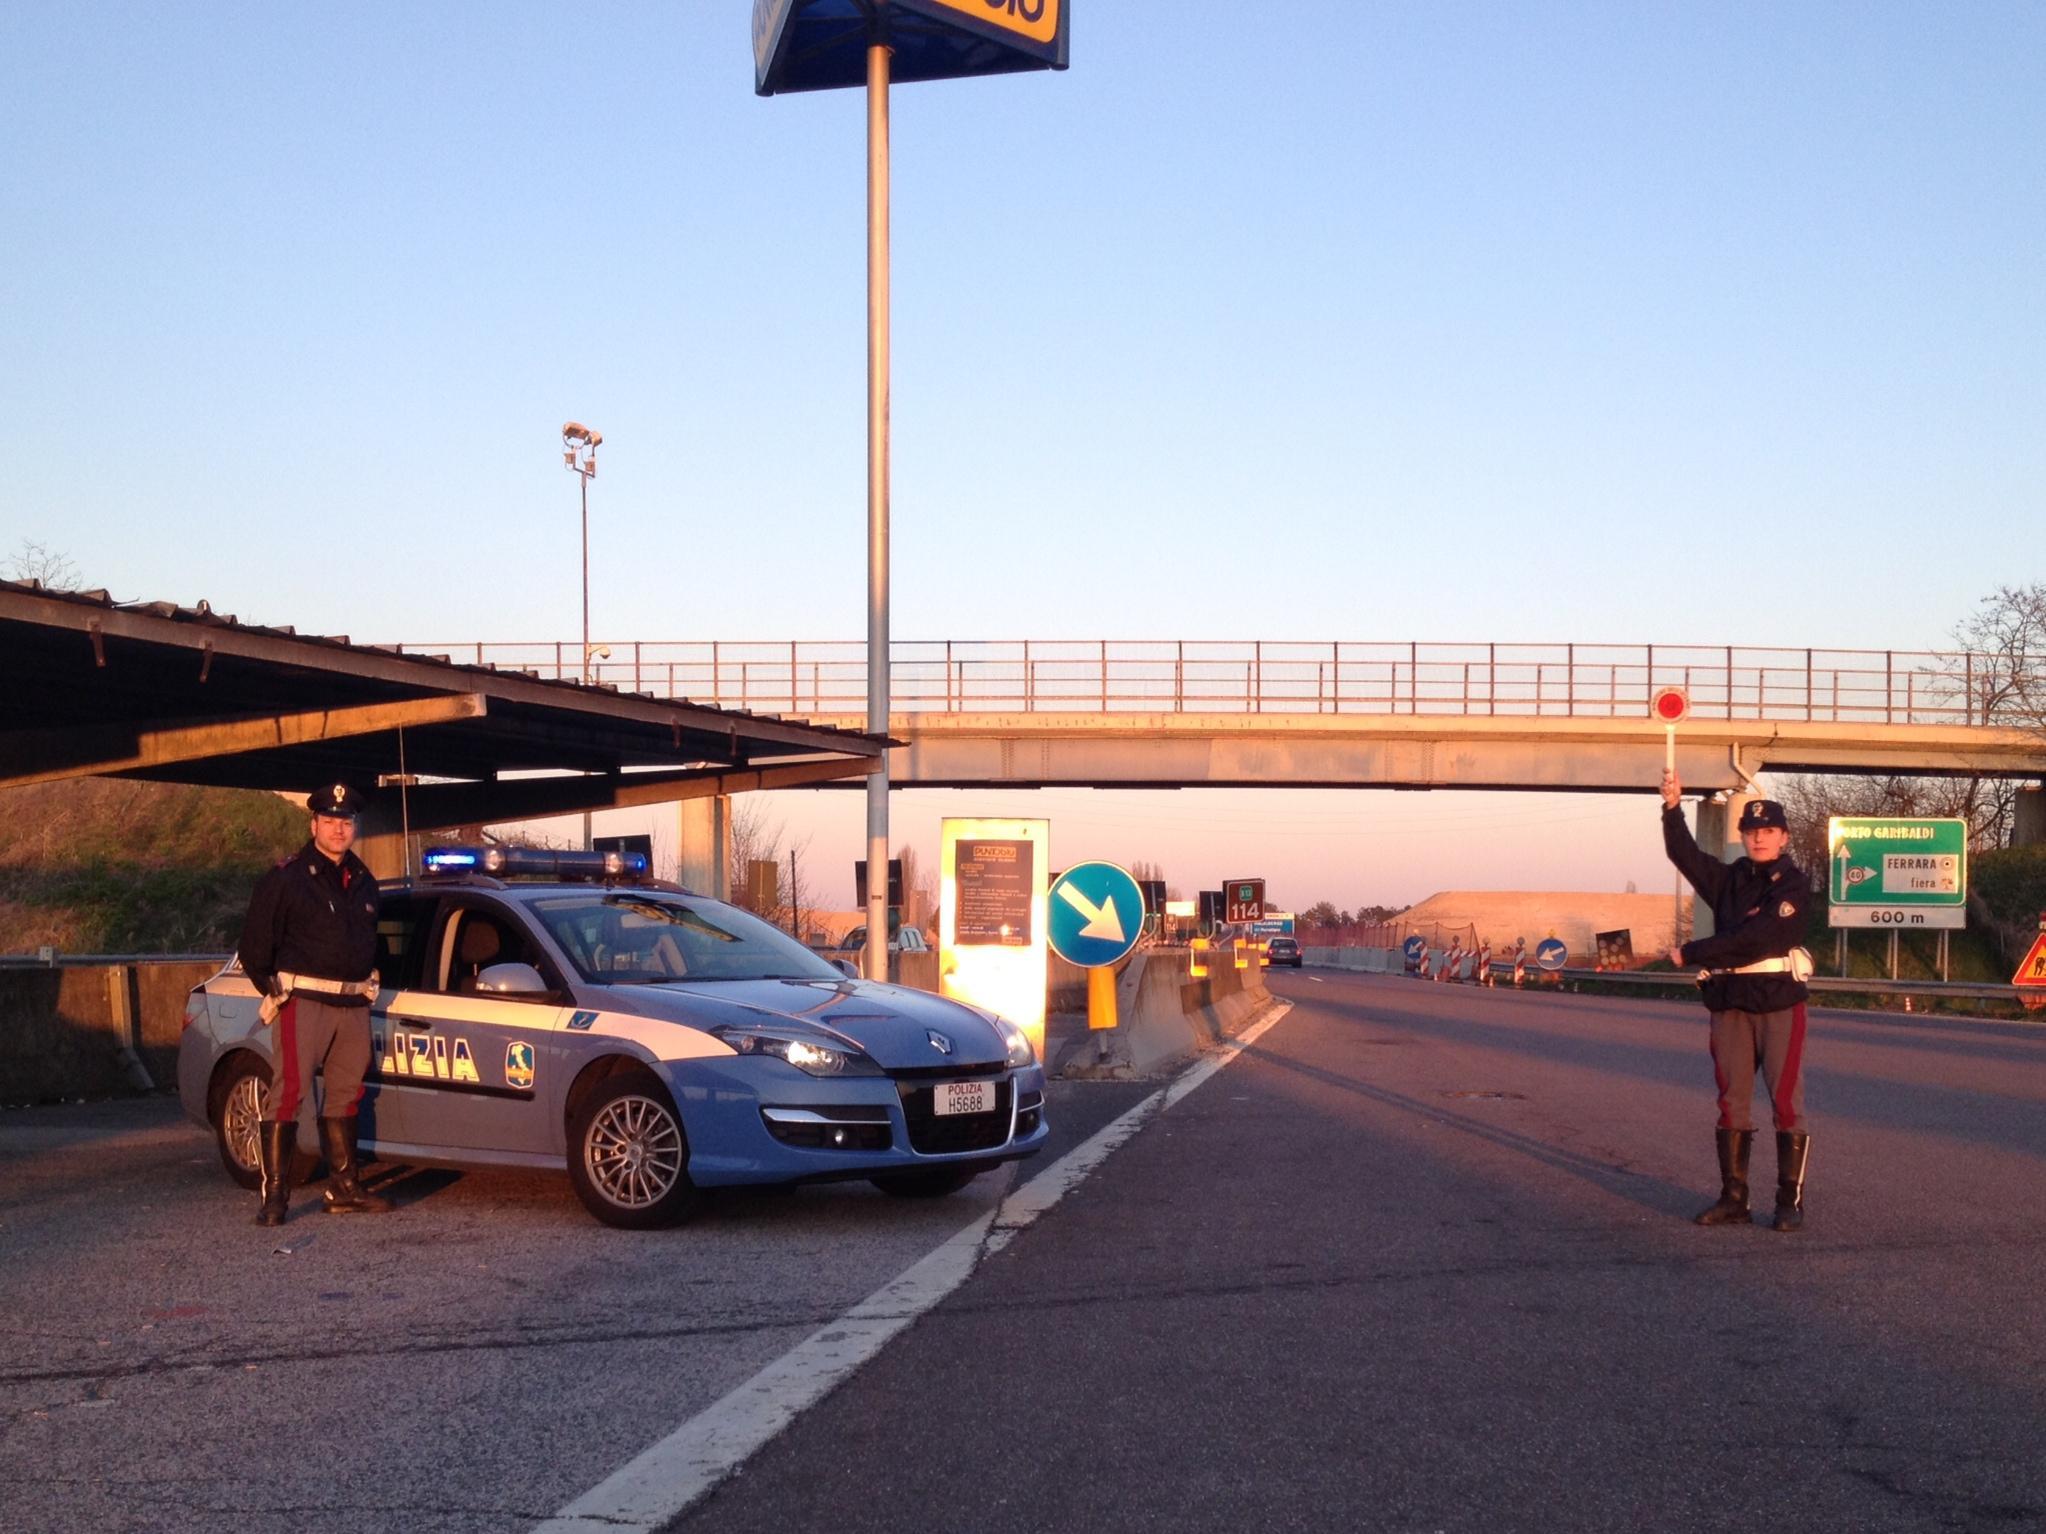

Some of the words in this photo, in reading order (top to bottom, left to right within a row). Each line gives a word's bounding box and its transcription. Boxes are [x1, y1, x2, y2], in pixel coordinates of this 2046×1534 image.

[1836, 827, 1871, 838] ORTO
[1873, 827, 1934, 839] GARIBALDI
[1887, 858, 1937, 869] FERRARA
[1911, 877, 1936, 888] fiera
[1232, 902, 1260, 920] 114
[1870, 911, 1905, 923] 600
[1911, 914, 1924, 923] m
[374, 1032, 480, 1082] LIZIA
[948, 1083, 983, 1095] POLIZIA
